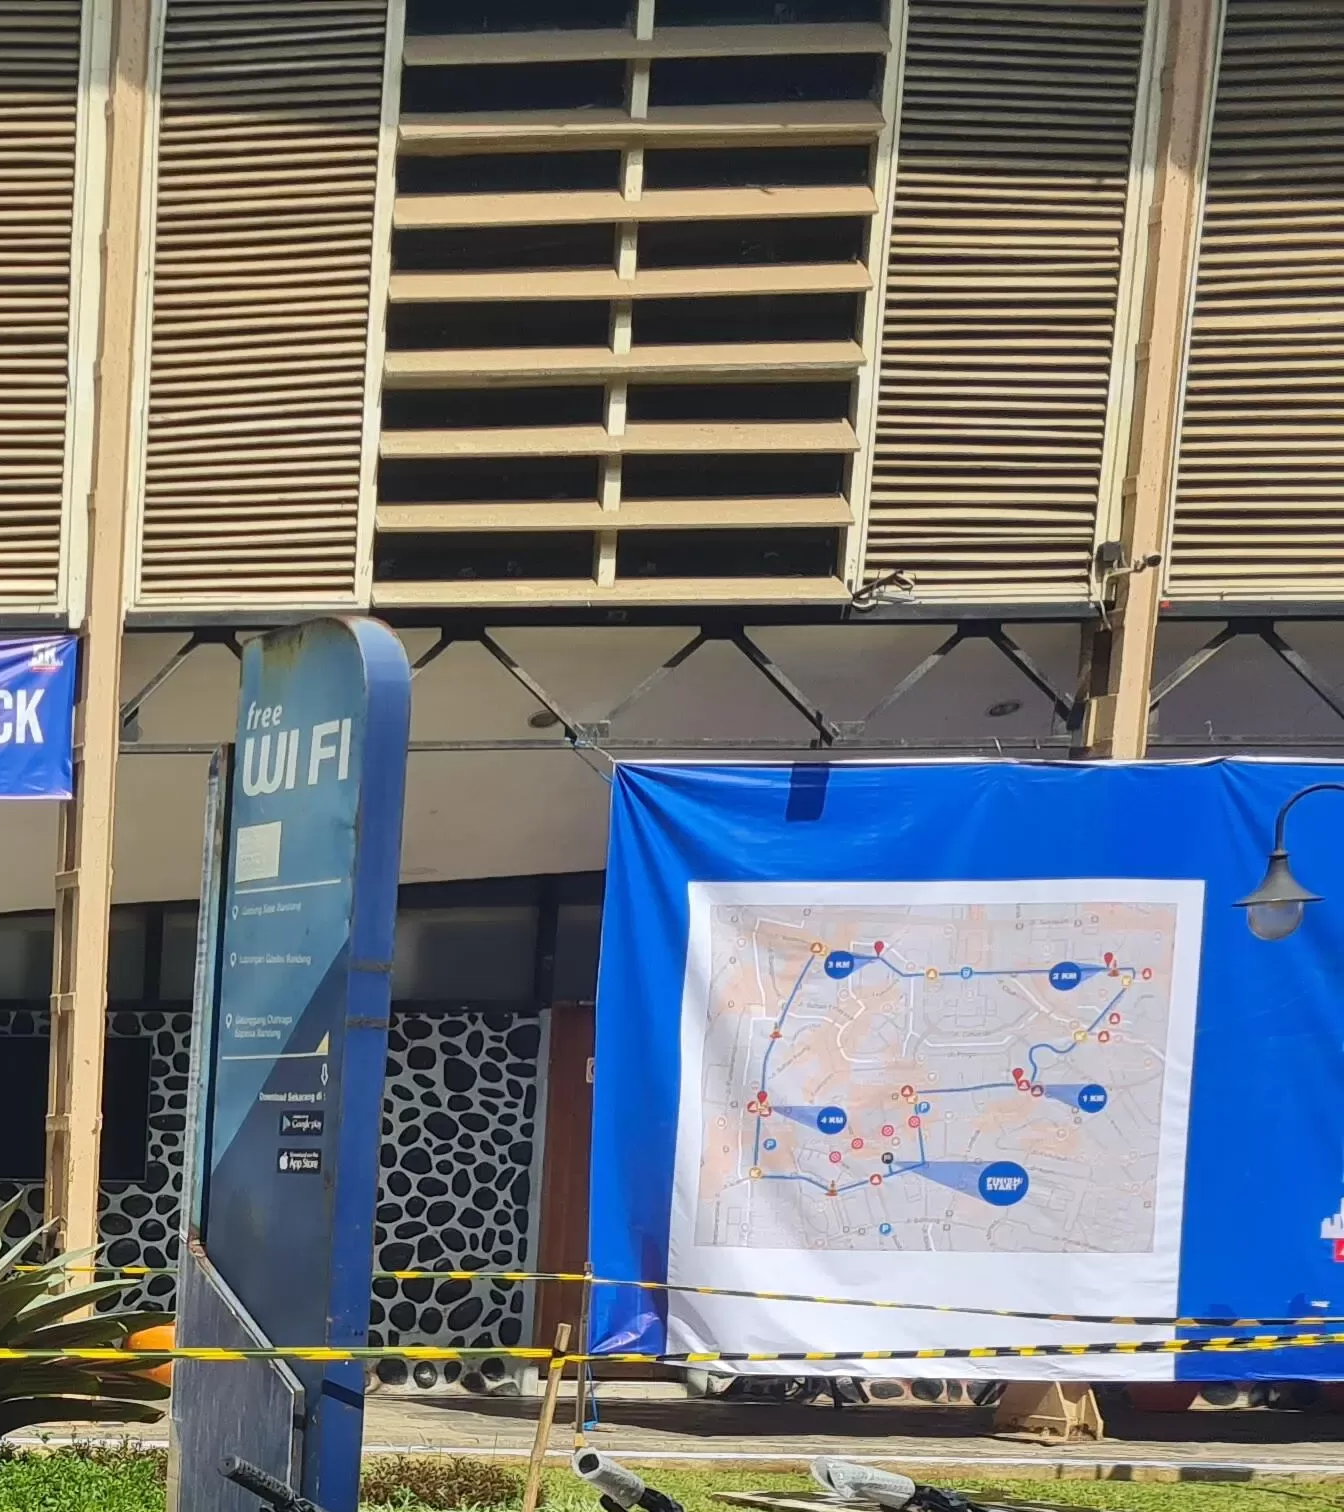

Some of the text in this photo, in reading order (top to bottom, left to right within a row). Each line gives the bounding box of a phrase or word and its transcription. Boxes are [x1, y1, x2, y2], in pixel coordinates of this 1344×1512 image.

[246, 701, 283, 731] free
[1052, 972, 1058, 981] 2
[820, 1116, 844, 1124] 4 KM
